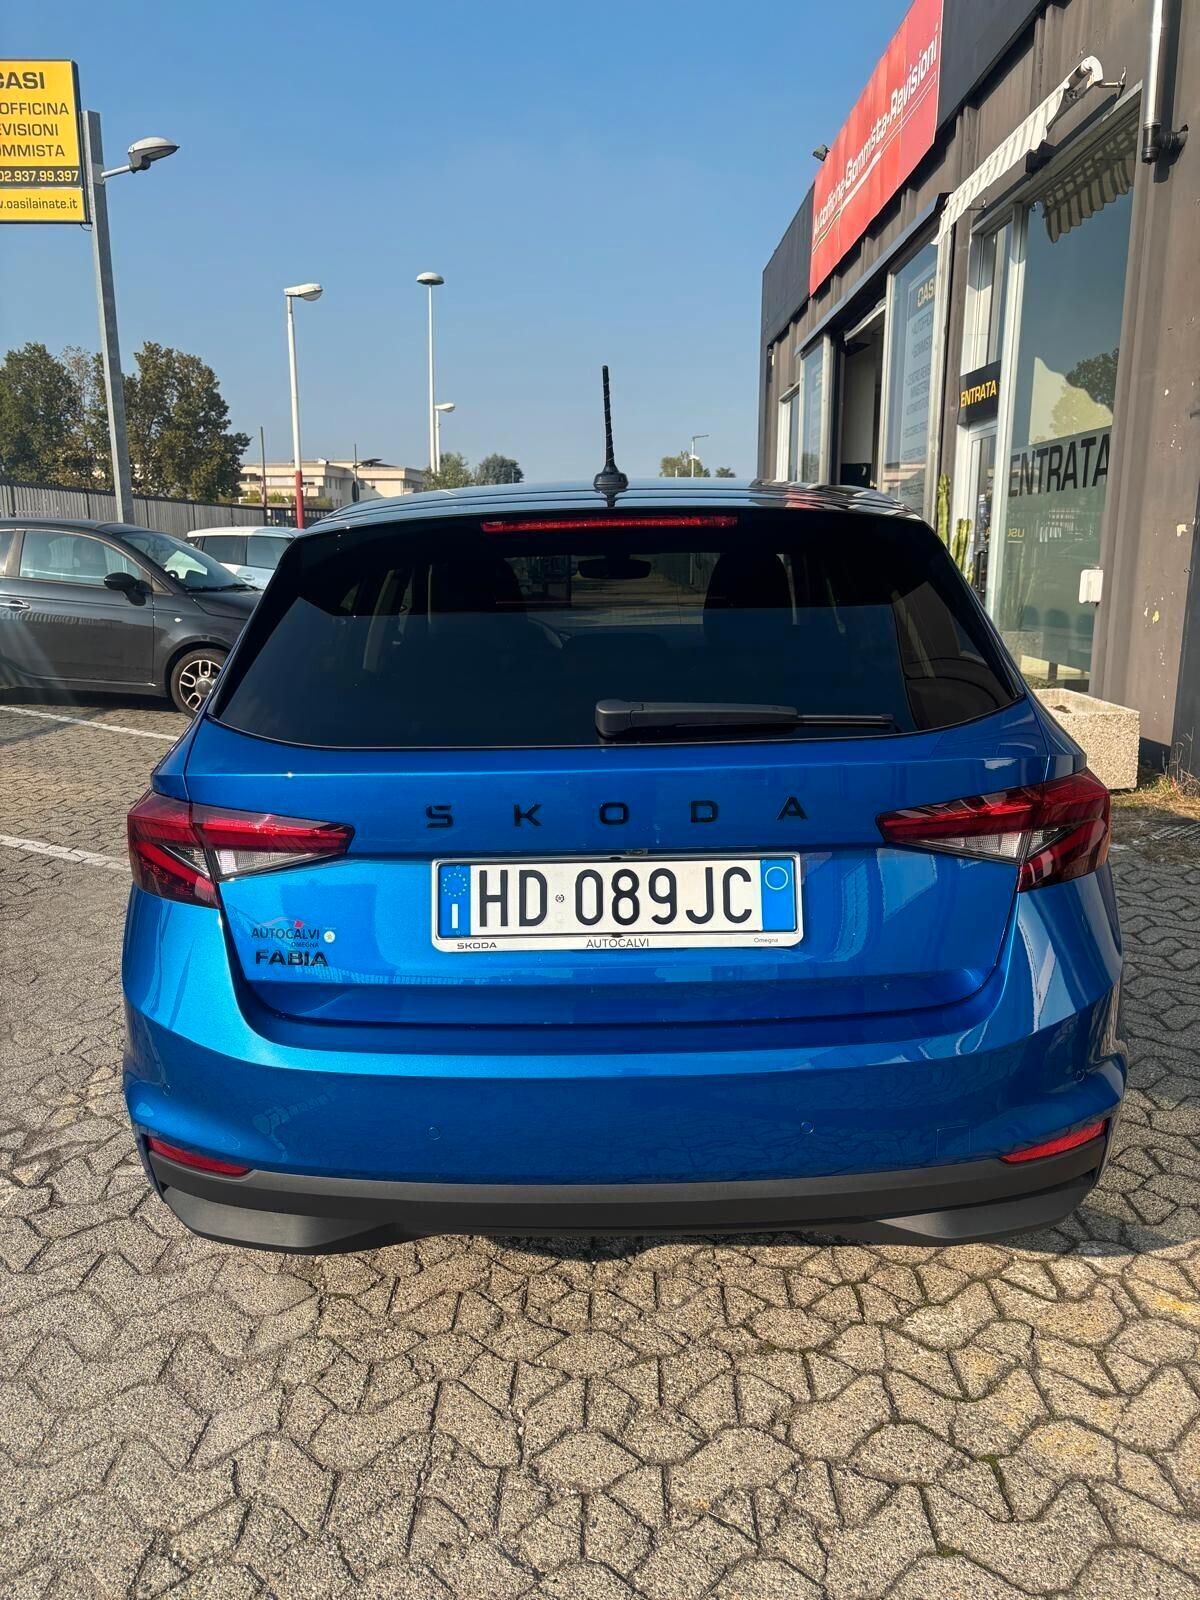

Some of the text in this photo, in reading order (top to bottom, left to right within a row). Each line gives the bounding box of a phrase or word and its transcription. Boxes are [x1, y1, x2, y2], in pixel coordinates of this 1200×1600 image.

[0, 71, 45, 89] ASI
[0, 123, 59, 136] VISIONI
[0, 144, 66, 157] MMISTA
[960, 379, 997, 408] ENTRATA
[1008, 433, 1110, 498] ENTRATA
[425, 796, 808, 829] SKODA
[479, 866, 752, 928] HD 089JC
[251, 927, 320, 940] AUTOCALVI
[456, 942, 498, 950] SKODA
[586, 938, 650, 948] AUTOCALVI
[255, 950, 329, 967] FABIA
